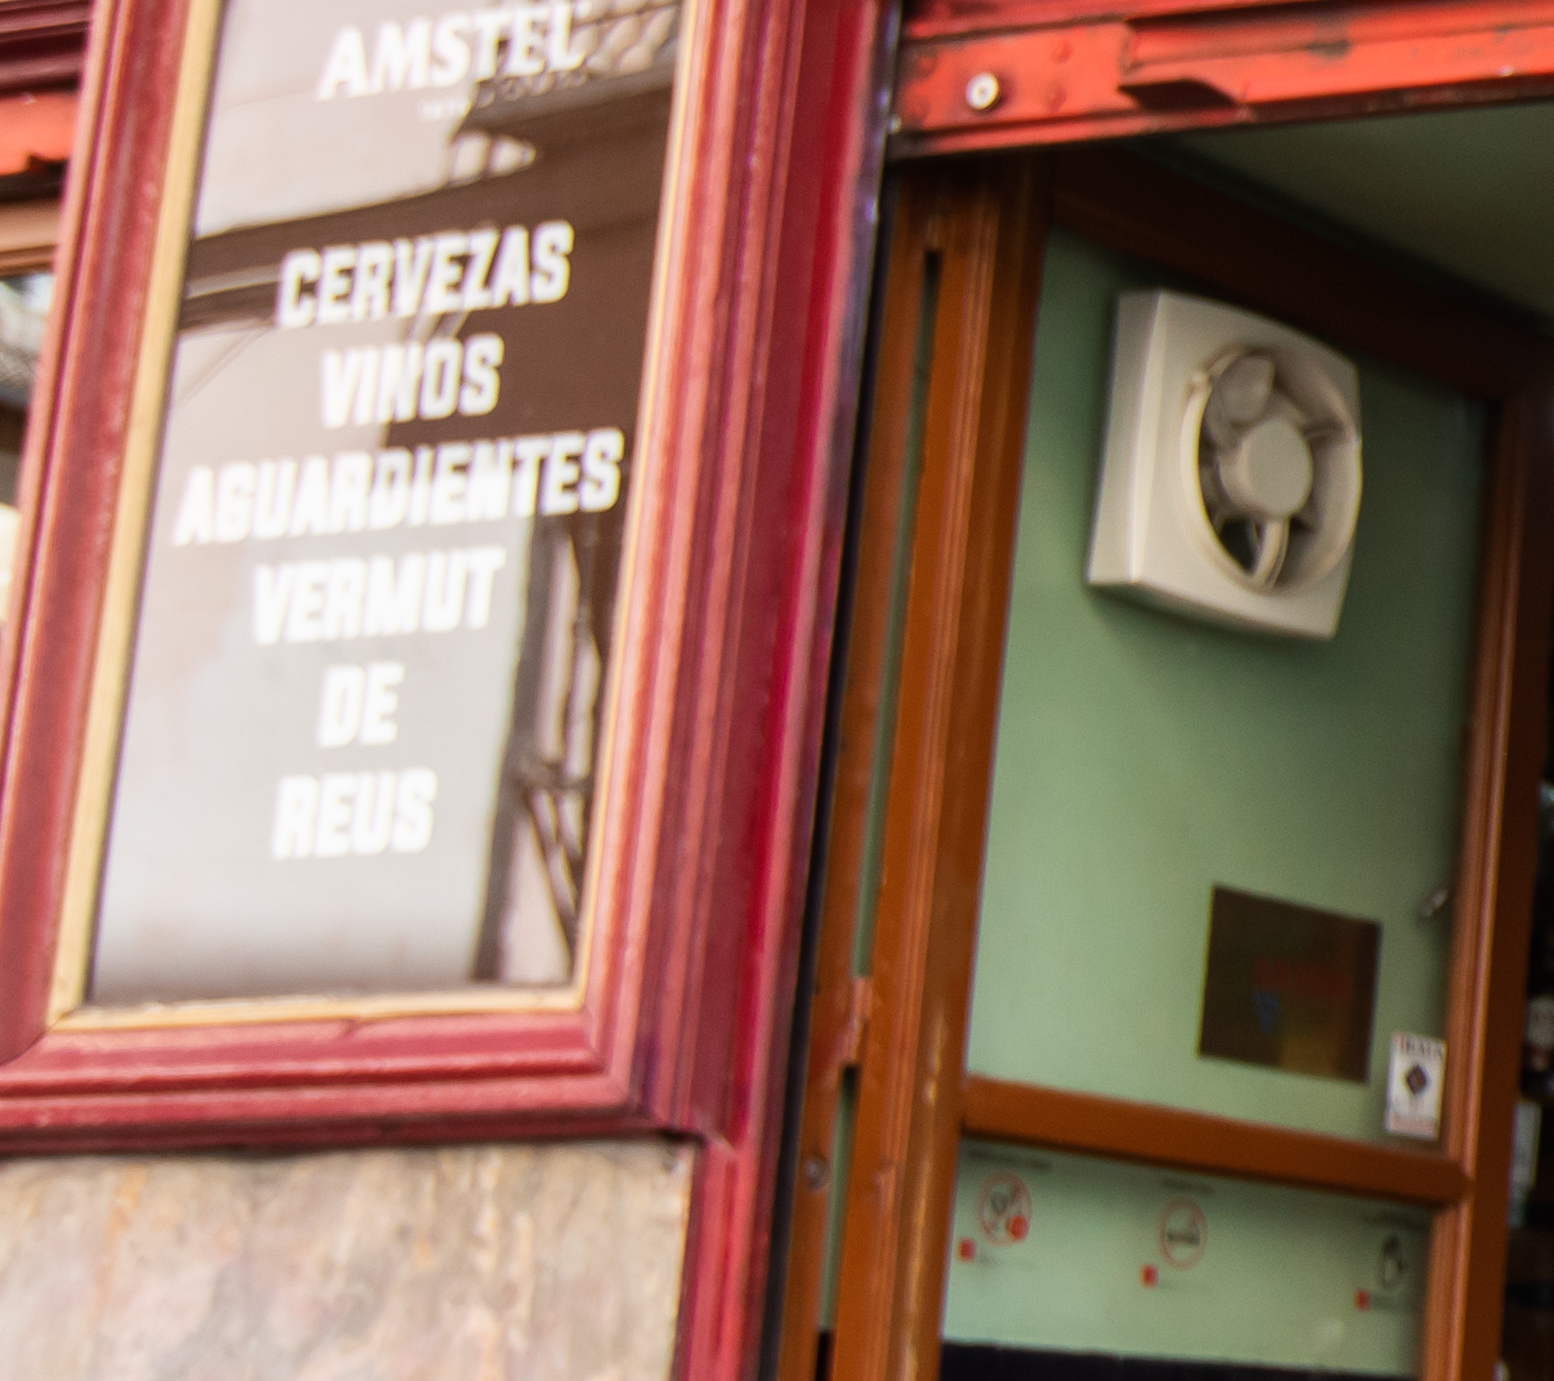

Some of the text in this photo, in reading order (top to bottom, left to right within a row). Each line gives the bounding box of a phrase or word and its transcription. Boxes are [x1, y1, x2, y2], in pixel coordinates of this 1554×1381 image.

[314, 0, 588, 102] AMSTEL
[277, 221, 574, 330] CERVEZAS
[321, 334, 504, 428] VINOS
[173, 428, 625, 546] AGUARDIENTES
[252, 546, 506, 646] VERMUT
[316, 661, 406, 749] DE
[271, 766, 438, 861] REUS
